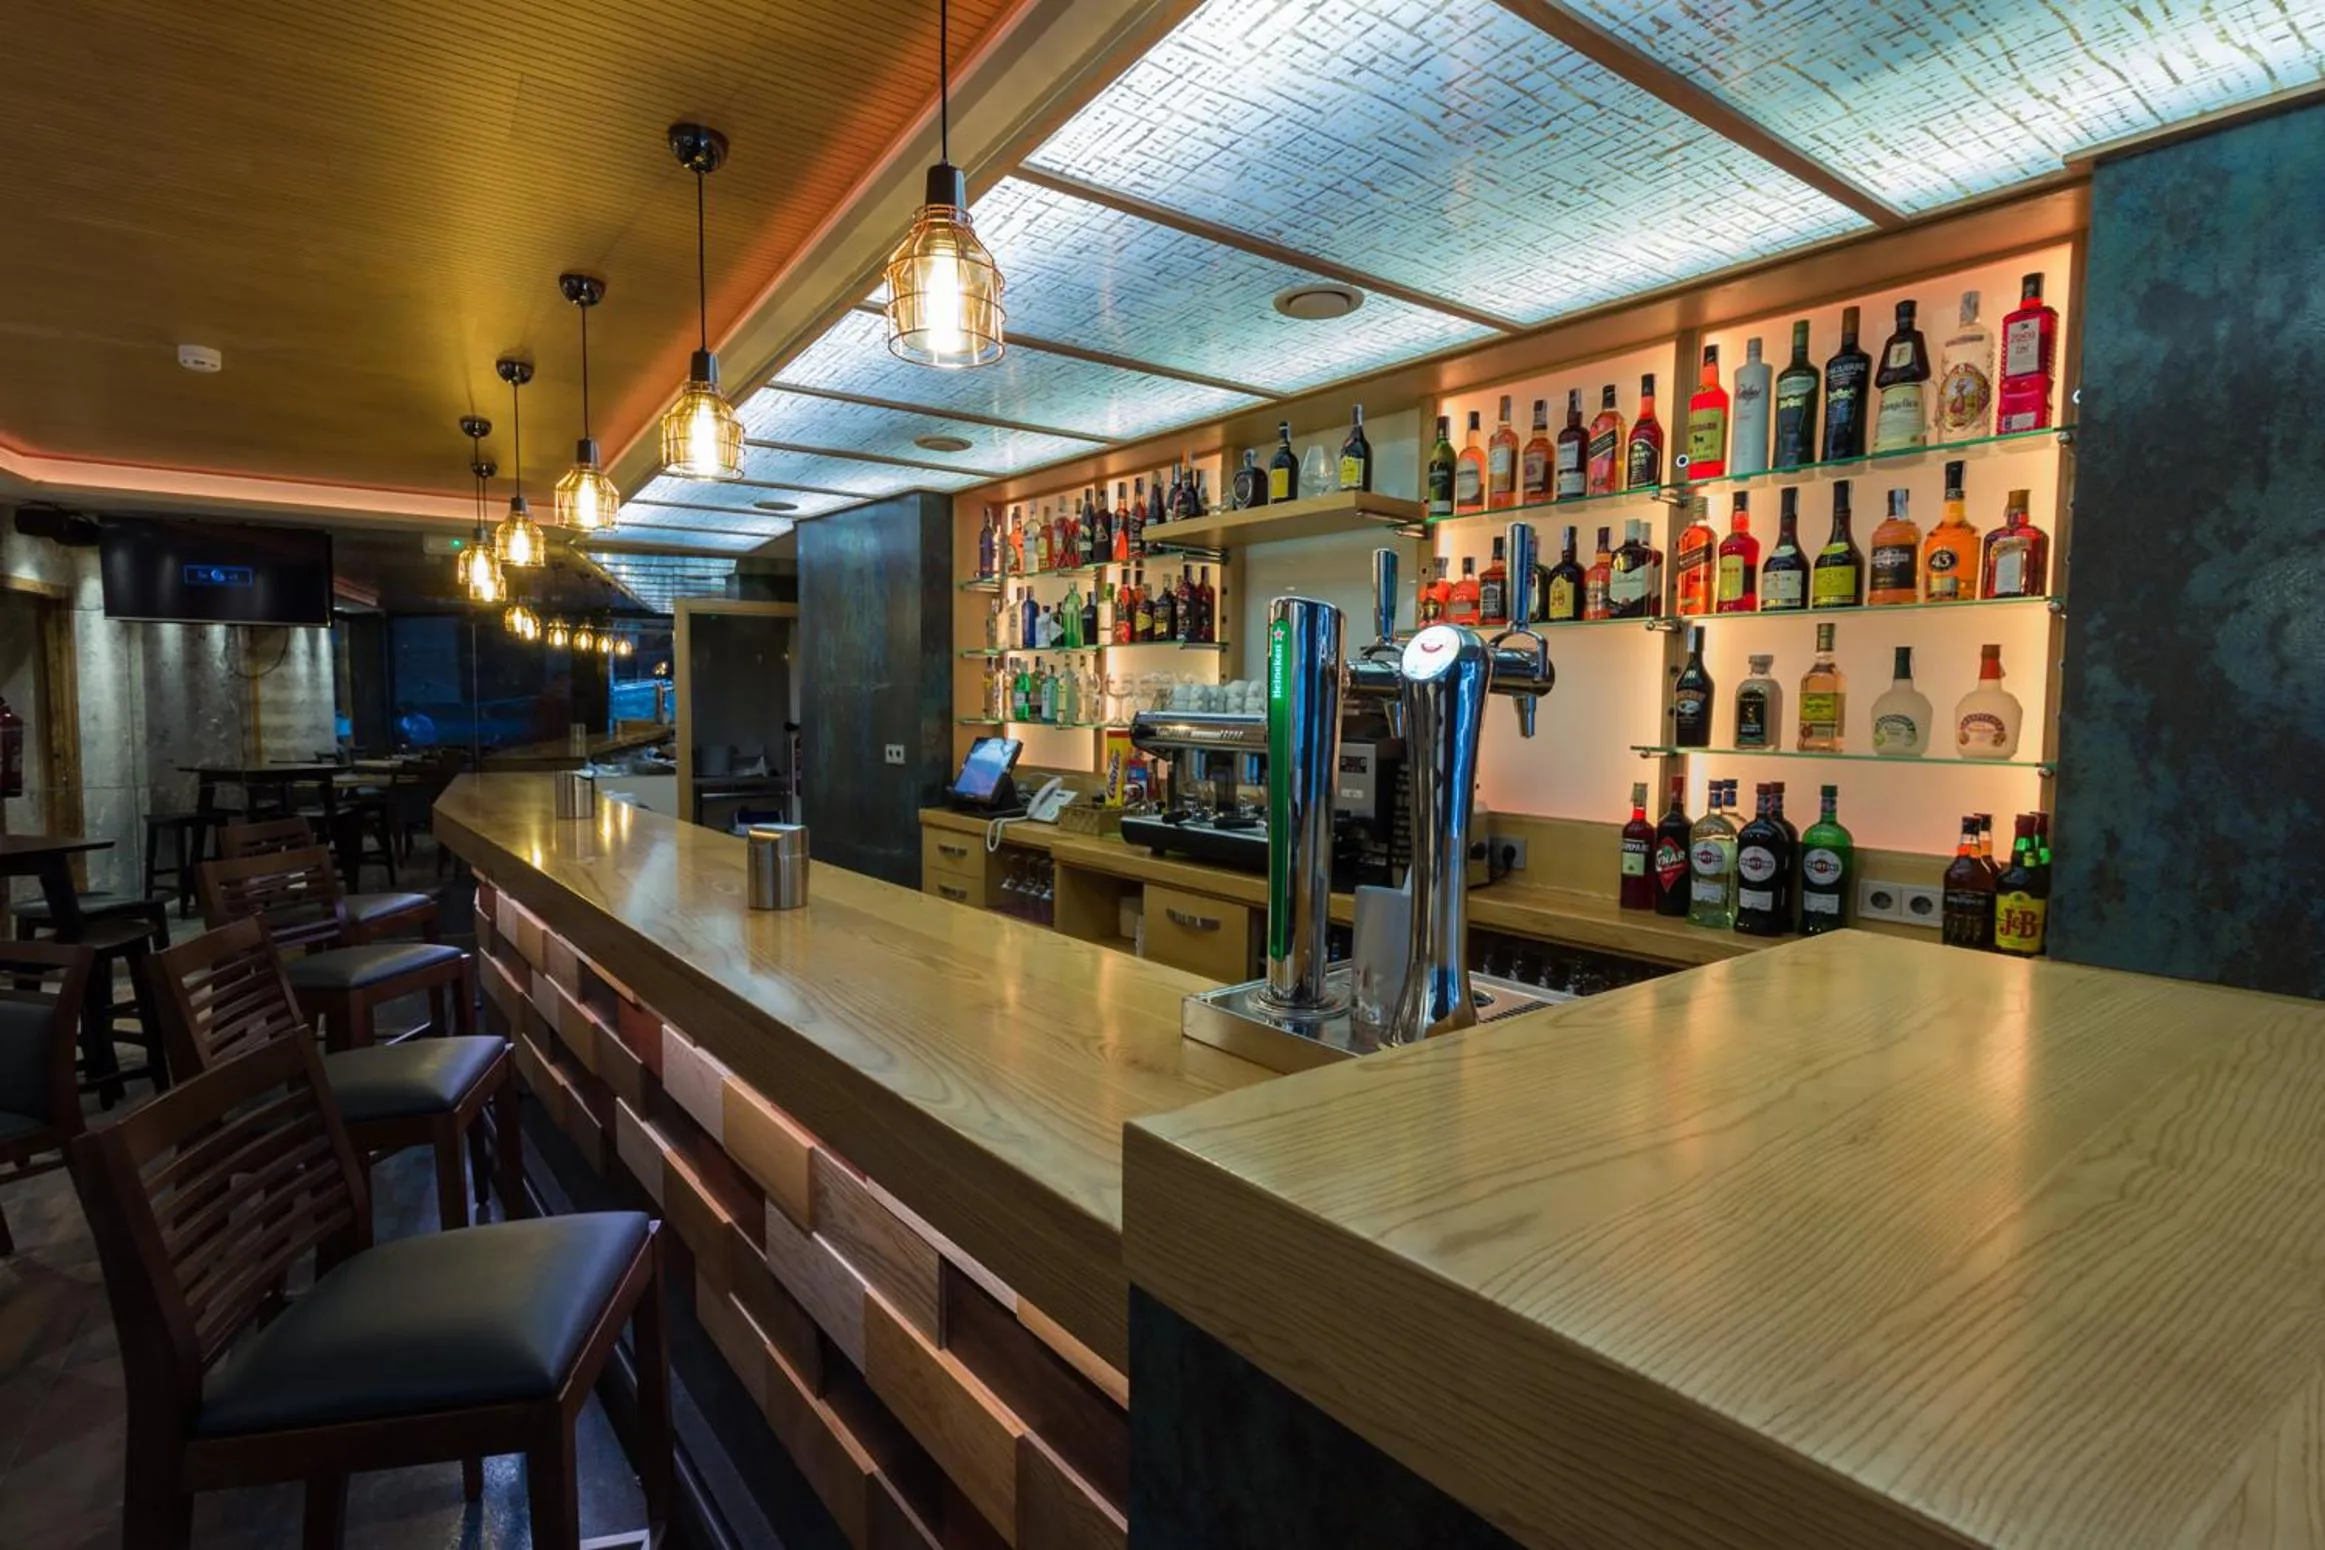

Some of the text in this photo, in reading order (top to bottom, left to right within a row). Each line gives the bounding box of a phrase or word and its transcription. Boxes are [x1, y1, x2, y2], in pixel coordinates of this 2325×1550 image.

[1930, 552, 1951, 568] 43
[1271, 644, 1284, 698] Heineken
[1999, 906, 2038, 939] J&B
